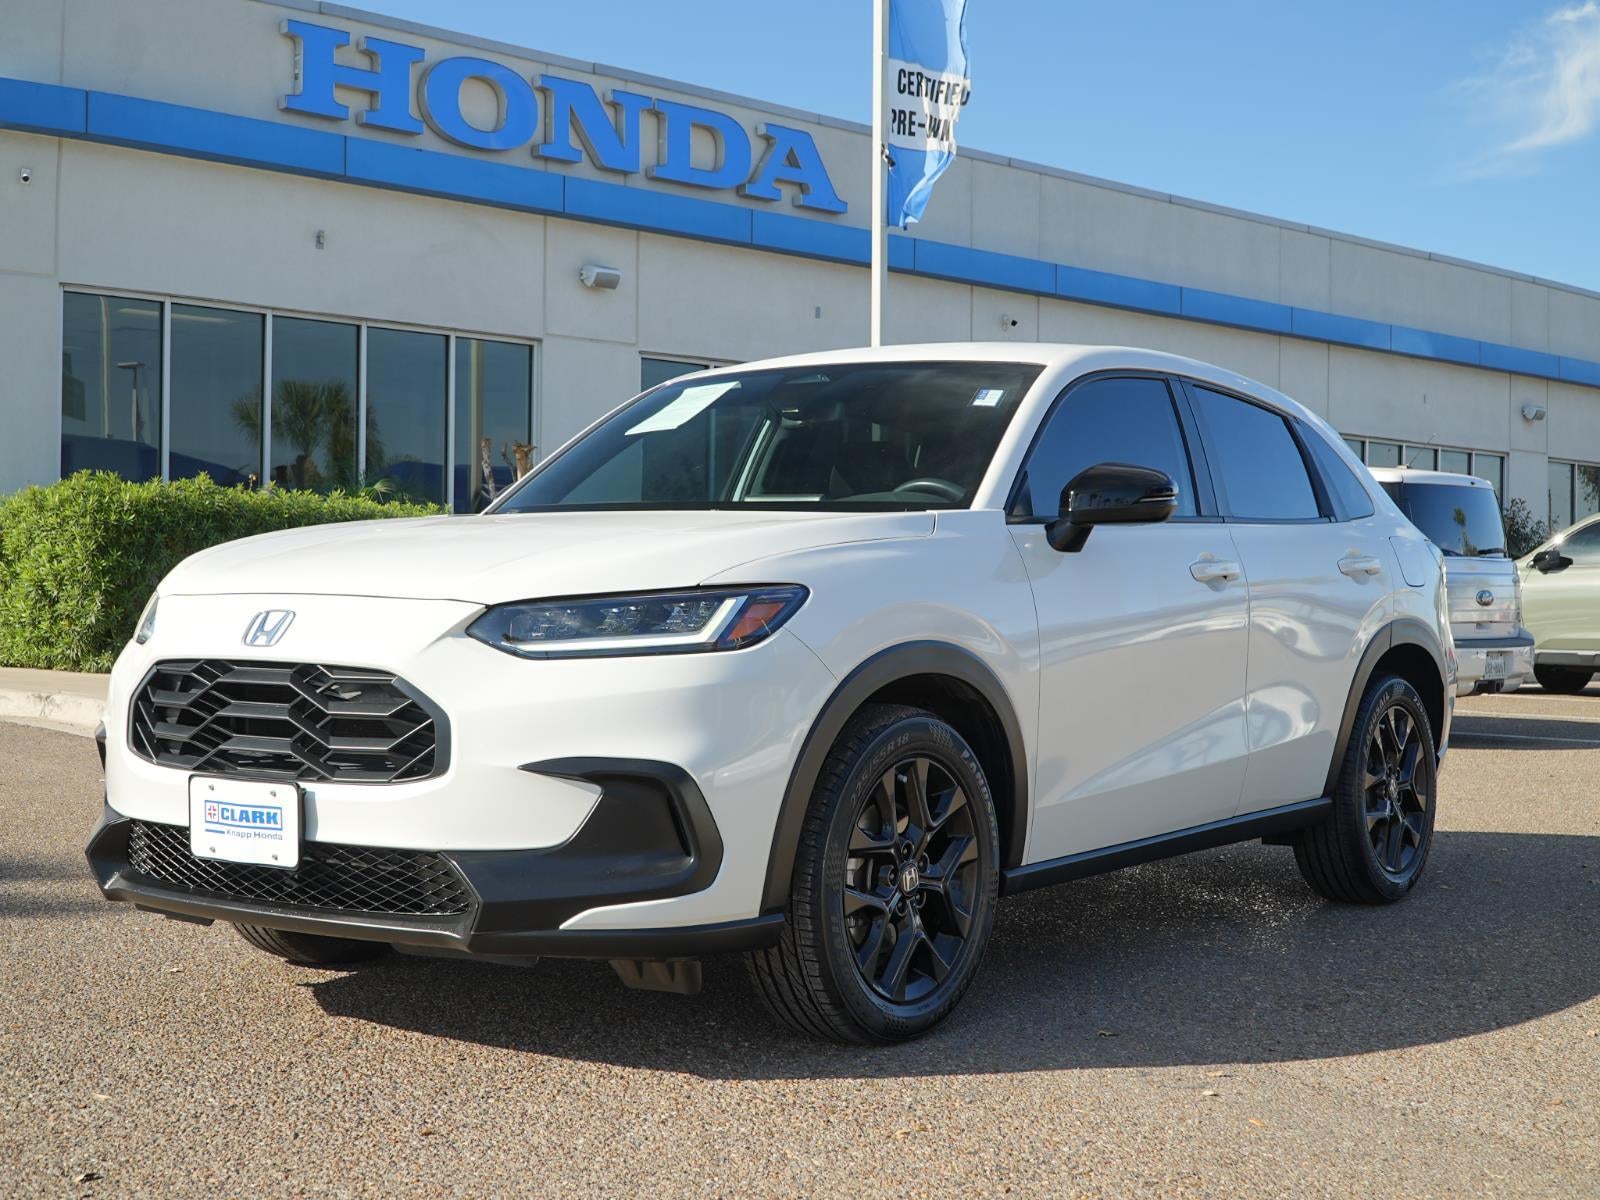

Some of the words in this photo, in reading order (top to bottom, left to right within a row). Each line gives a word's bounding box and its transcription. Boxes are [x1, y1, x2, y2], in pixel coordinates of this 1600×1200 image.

[897, 68, 971, 106] CERTIFIED
[279, 19, 848, 214] HONDA
[220, 806, 279, 825] CLARK
[226, 829, 252, 840] Knapp
[253, 831, 283, 841] Honda
